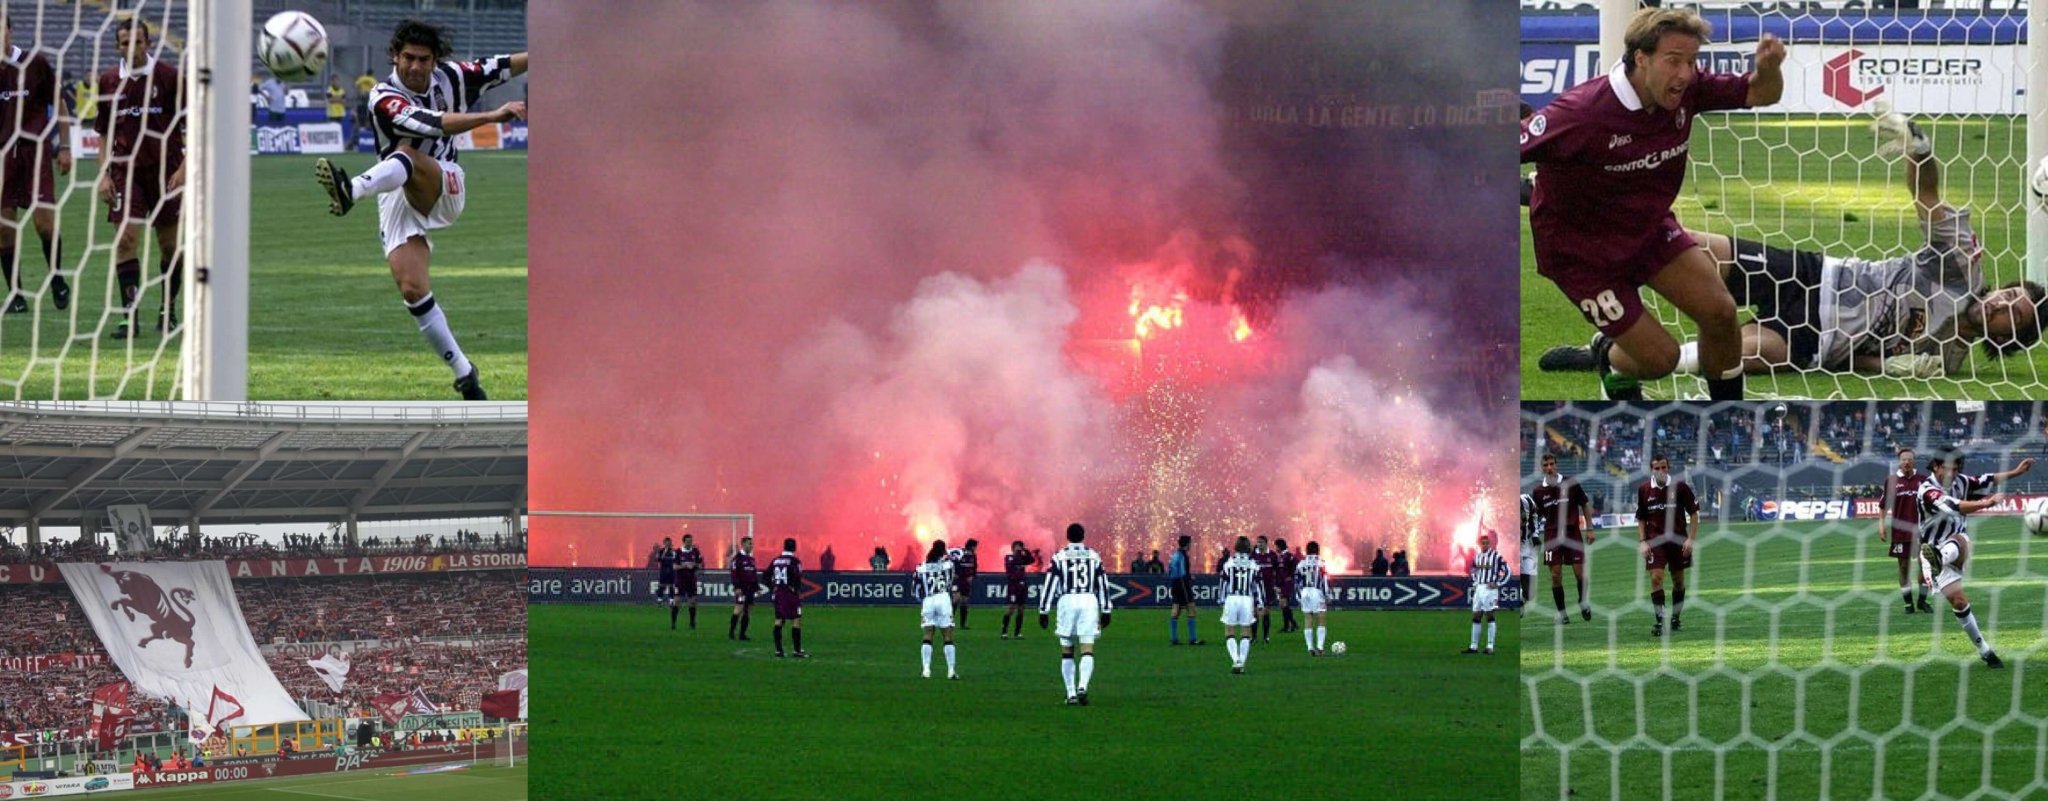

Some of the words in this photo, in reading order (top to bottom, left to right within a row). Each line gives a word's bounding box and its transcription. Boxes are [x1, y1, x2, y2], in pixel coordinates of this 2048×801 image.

[1858, 58, 1983, 76] ROEDER
[1521, 59, 1570, 94] SI
[1858, 76, 1892, 86] 1956
[1580, 288, 1625, 327] 28
[1779, 500, 1850, 520] PEPSI
[1893, 543, 1904, 554] 28
[381, 555, 428, 572] 1906
[449, 554, 468, 567] LA
[472, 553, 527, 567] STORIA
[1069, 563, 1089, 588] 13
[571, 575, 632, 595] avanti
[827, 581, 904, 600] pensare
[1346, 586, 1392, 601] STILO
[155, 770, 209, 783] Kappa
[214, 766, 249, 781] 00:00
